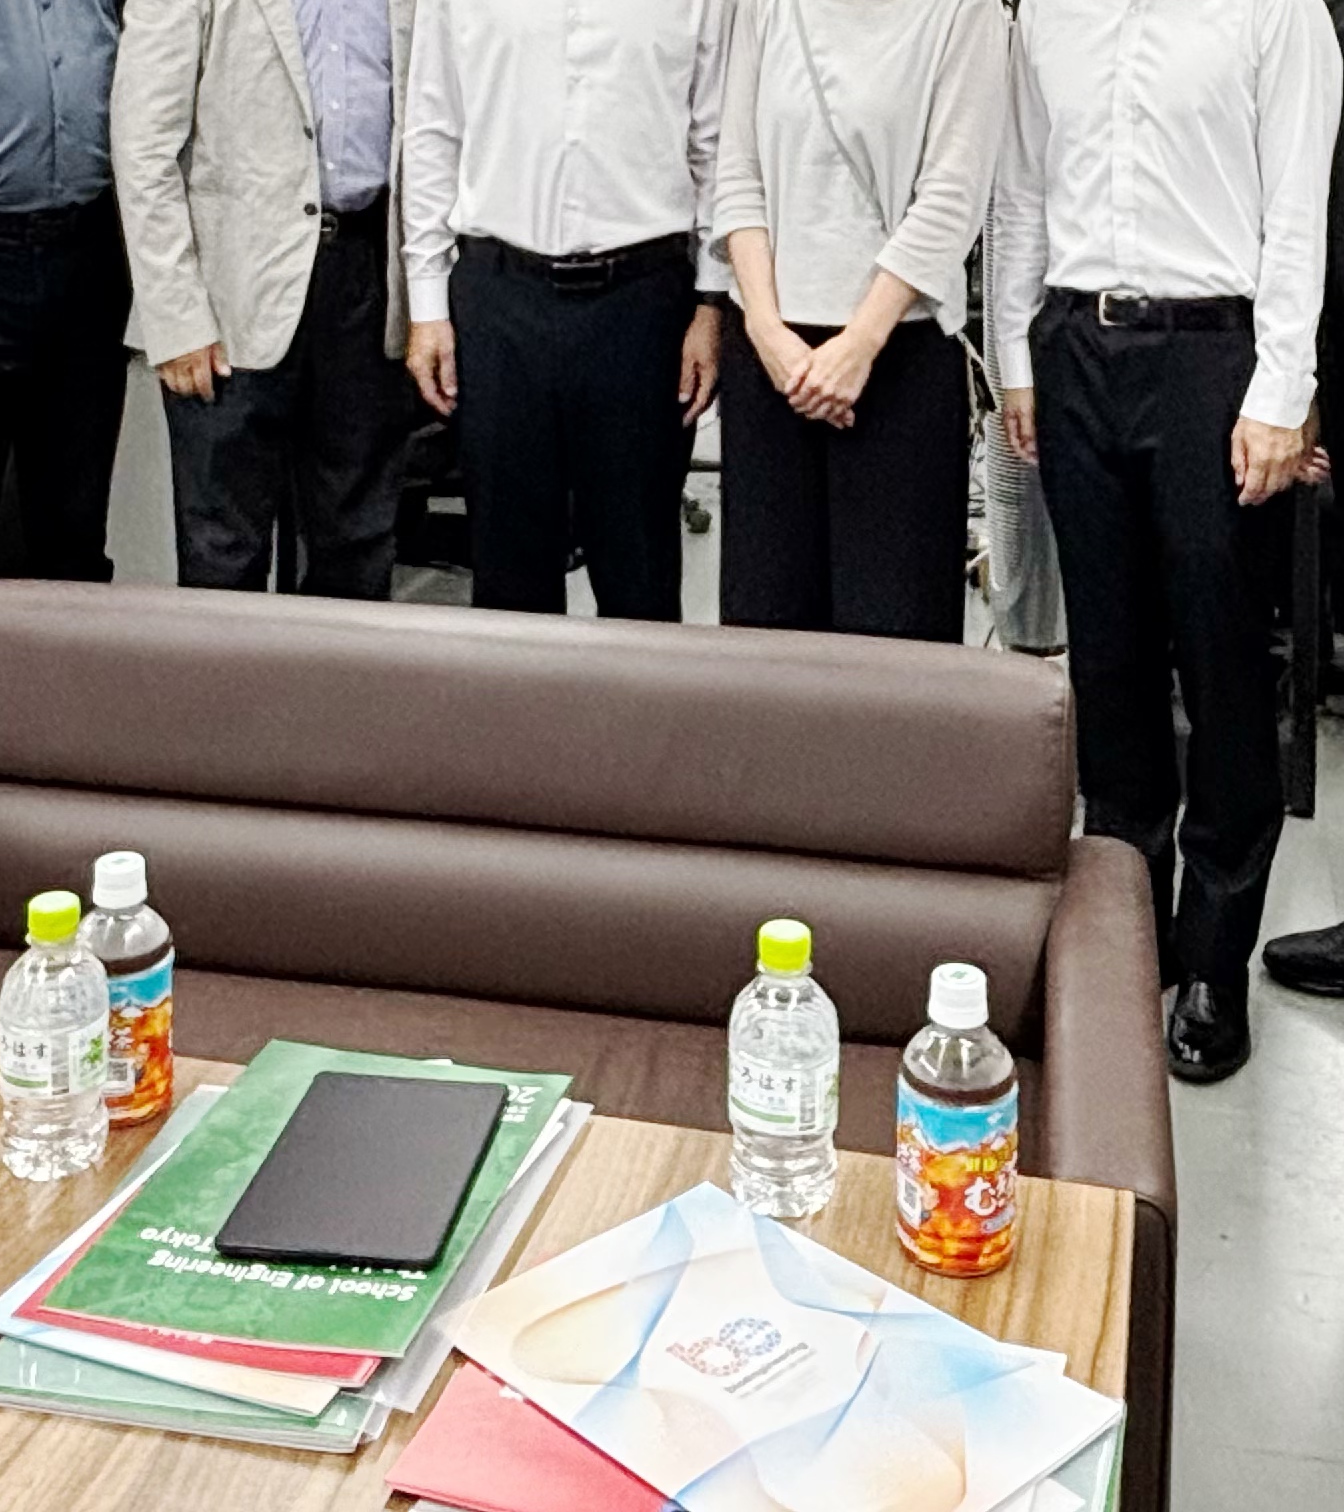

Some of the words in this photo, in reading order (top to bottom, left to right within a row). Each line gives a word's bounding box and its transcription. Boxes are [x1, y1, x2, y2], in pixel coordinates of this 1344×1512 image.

[139, 1227, 215, 1253] Tokyo
[146, 1248, 294, 1289] Engineering
[292, 1273, 326, 1290] of
[328, 1277, 418, 1302] School
